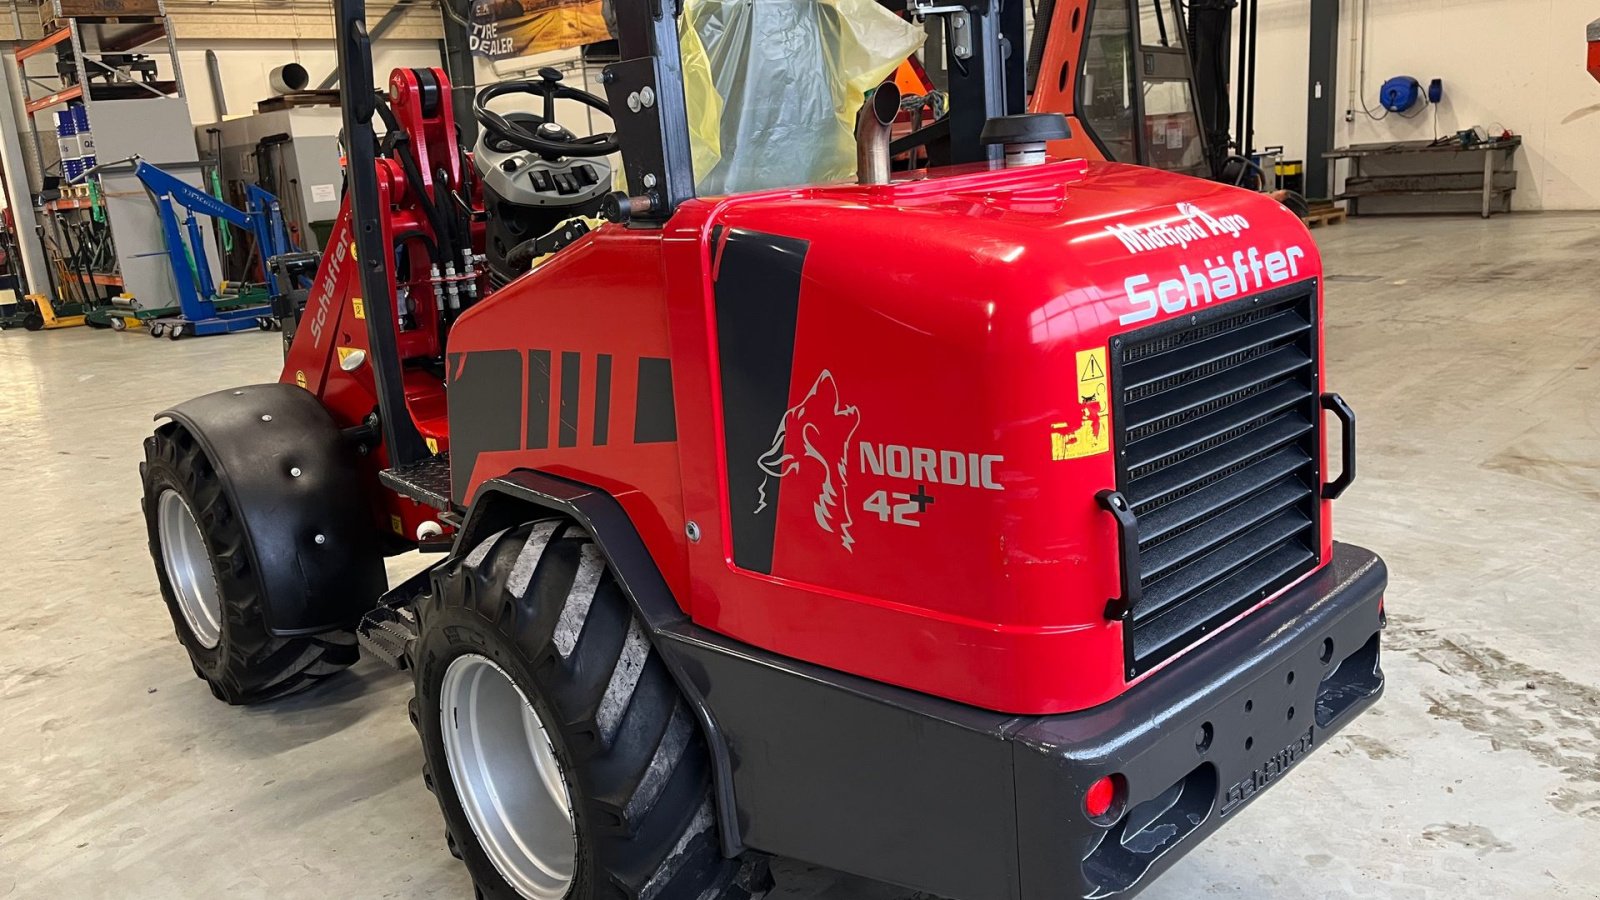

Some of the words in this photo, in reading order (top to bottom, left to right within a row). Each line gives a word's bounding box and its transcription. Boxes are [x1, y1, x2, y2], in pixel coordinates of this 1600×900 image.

[469, 35, 514, 56] DEALER
[472, 22, 498, 39] TIRE
[1104, 212, 1210, 254] Midtfjord
[1197, 209, 1250, 239] Agro
[310, 228, 348, 349] Schäffer
[1119, 245, 1305, 326] Schäffer
[859, 441, 1005, 490] NORDIC
